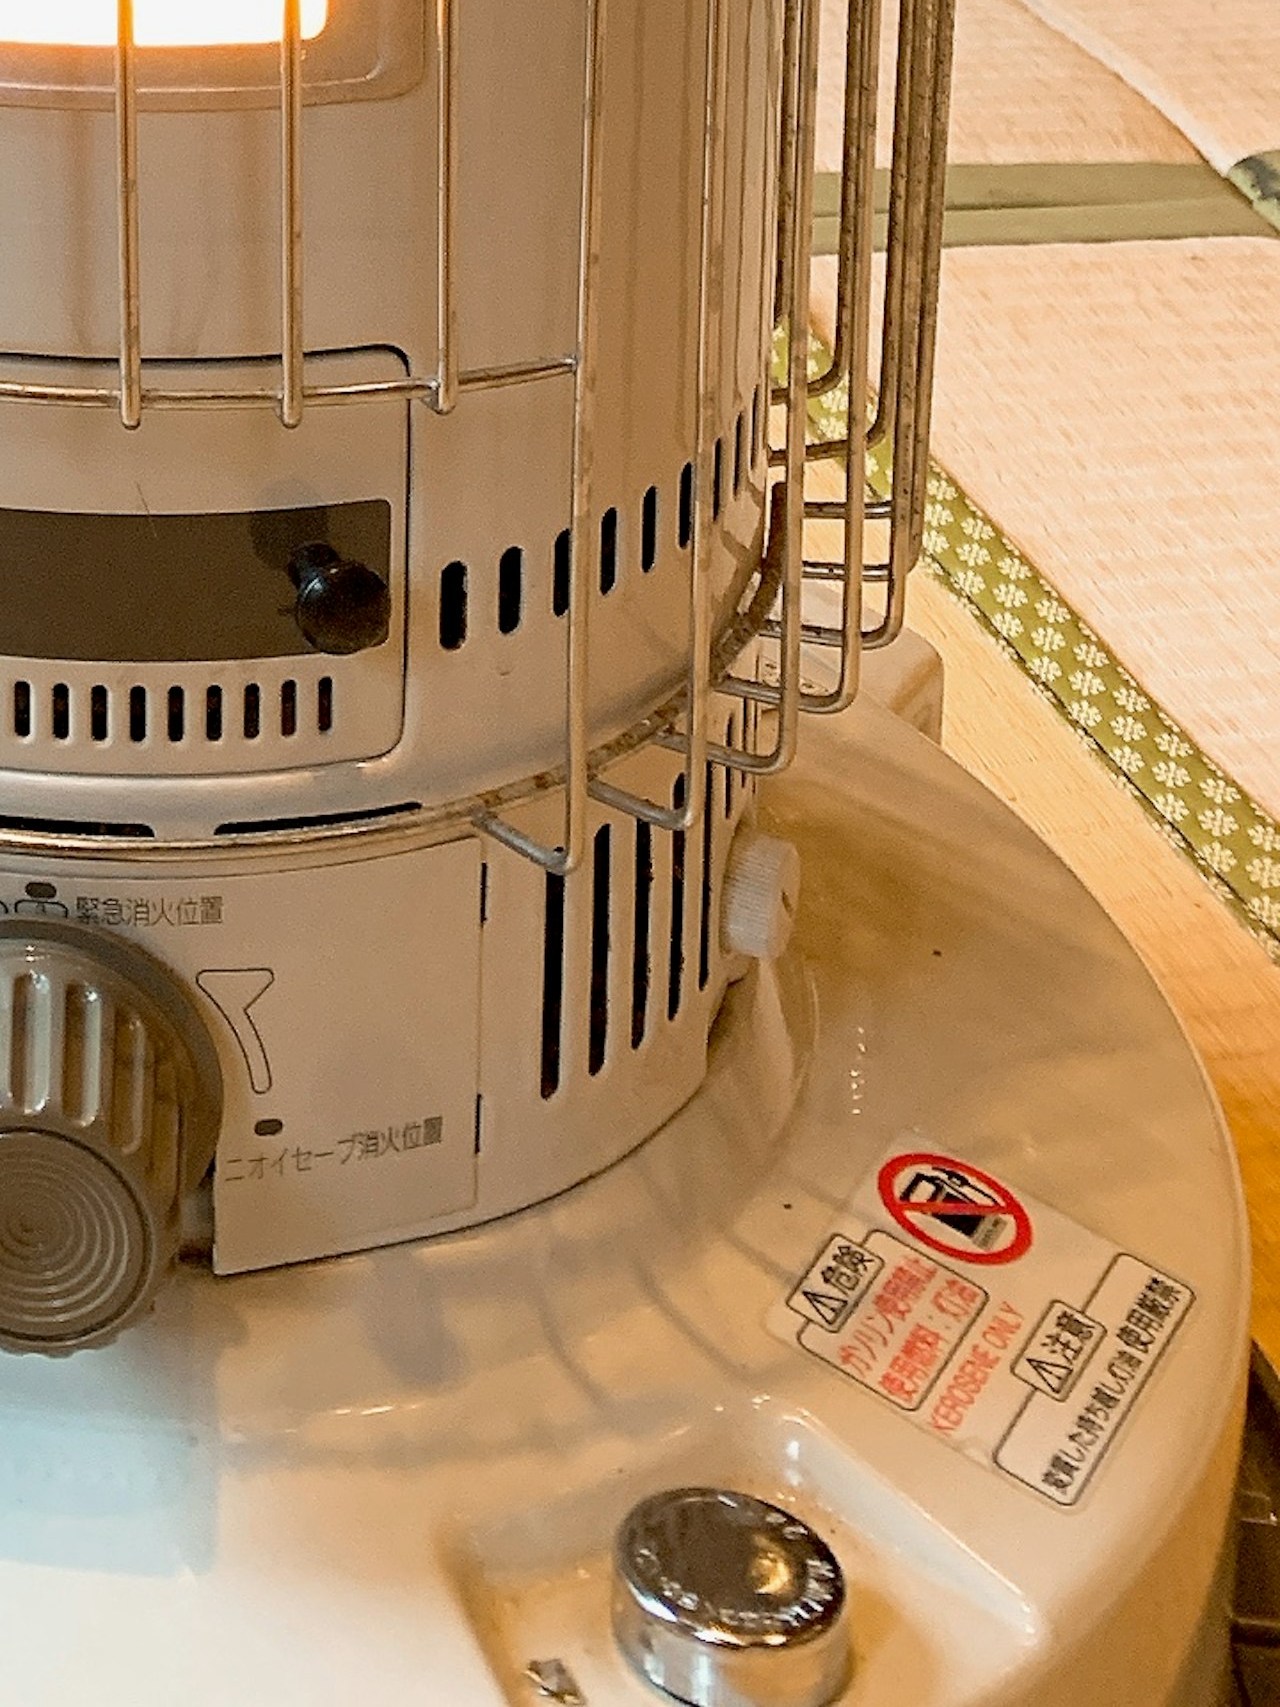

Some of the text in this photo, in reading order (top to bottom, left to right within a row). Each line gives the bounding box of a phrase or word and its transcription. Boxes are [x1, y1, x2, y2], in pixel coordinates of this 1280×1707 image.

[77, 895, 224, 927] 緊急消火位置
[820, 1244, 874, 1295] 危険
[1040, 1309, 1096, 1366] 注意
[930, 1343, 1002, 1436] KEROSENE
[981, 1300, 1025, 1352] ONLY
